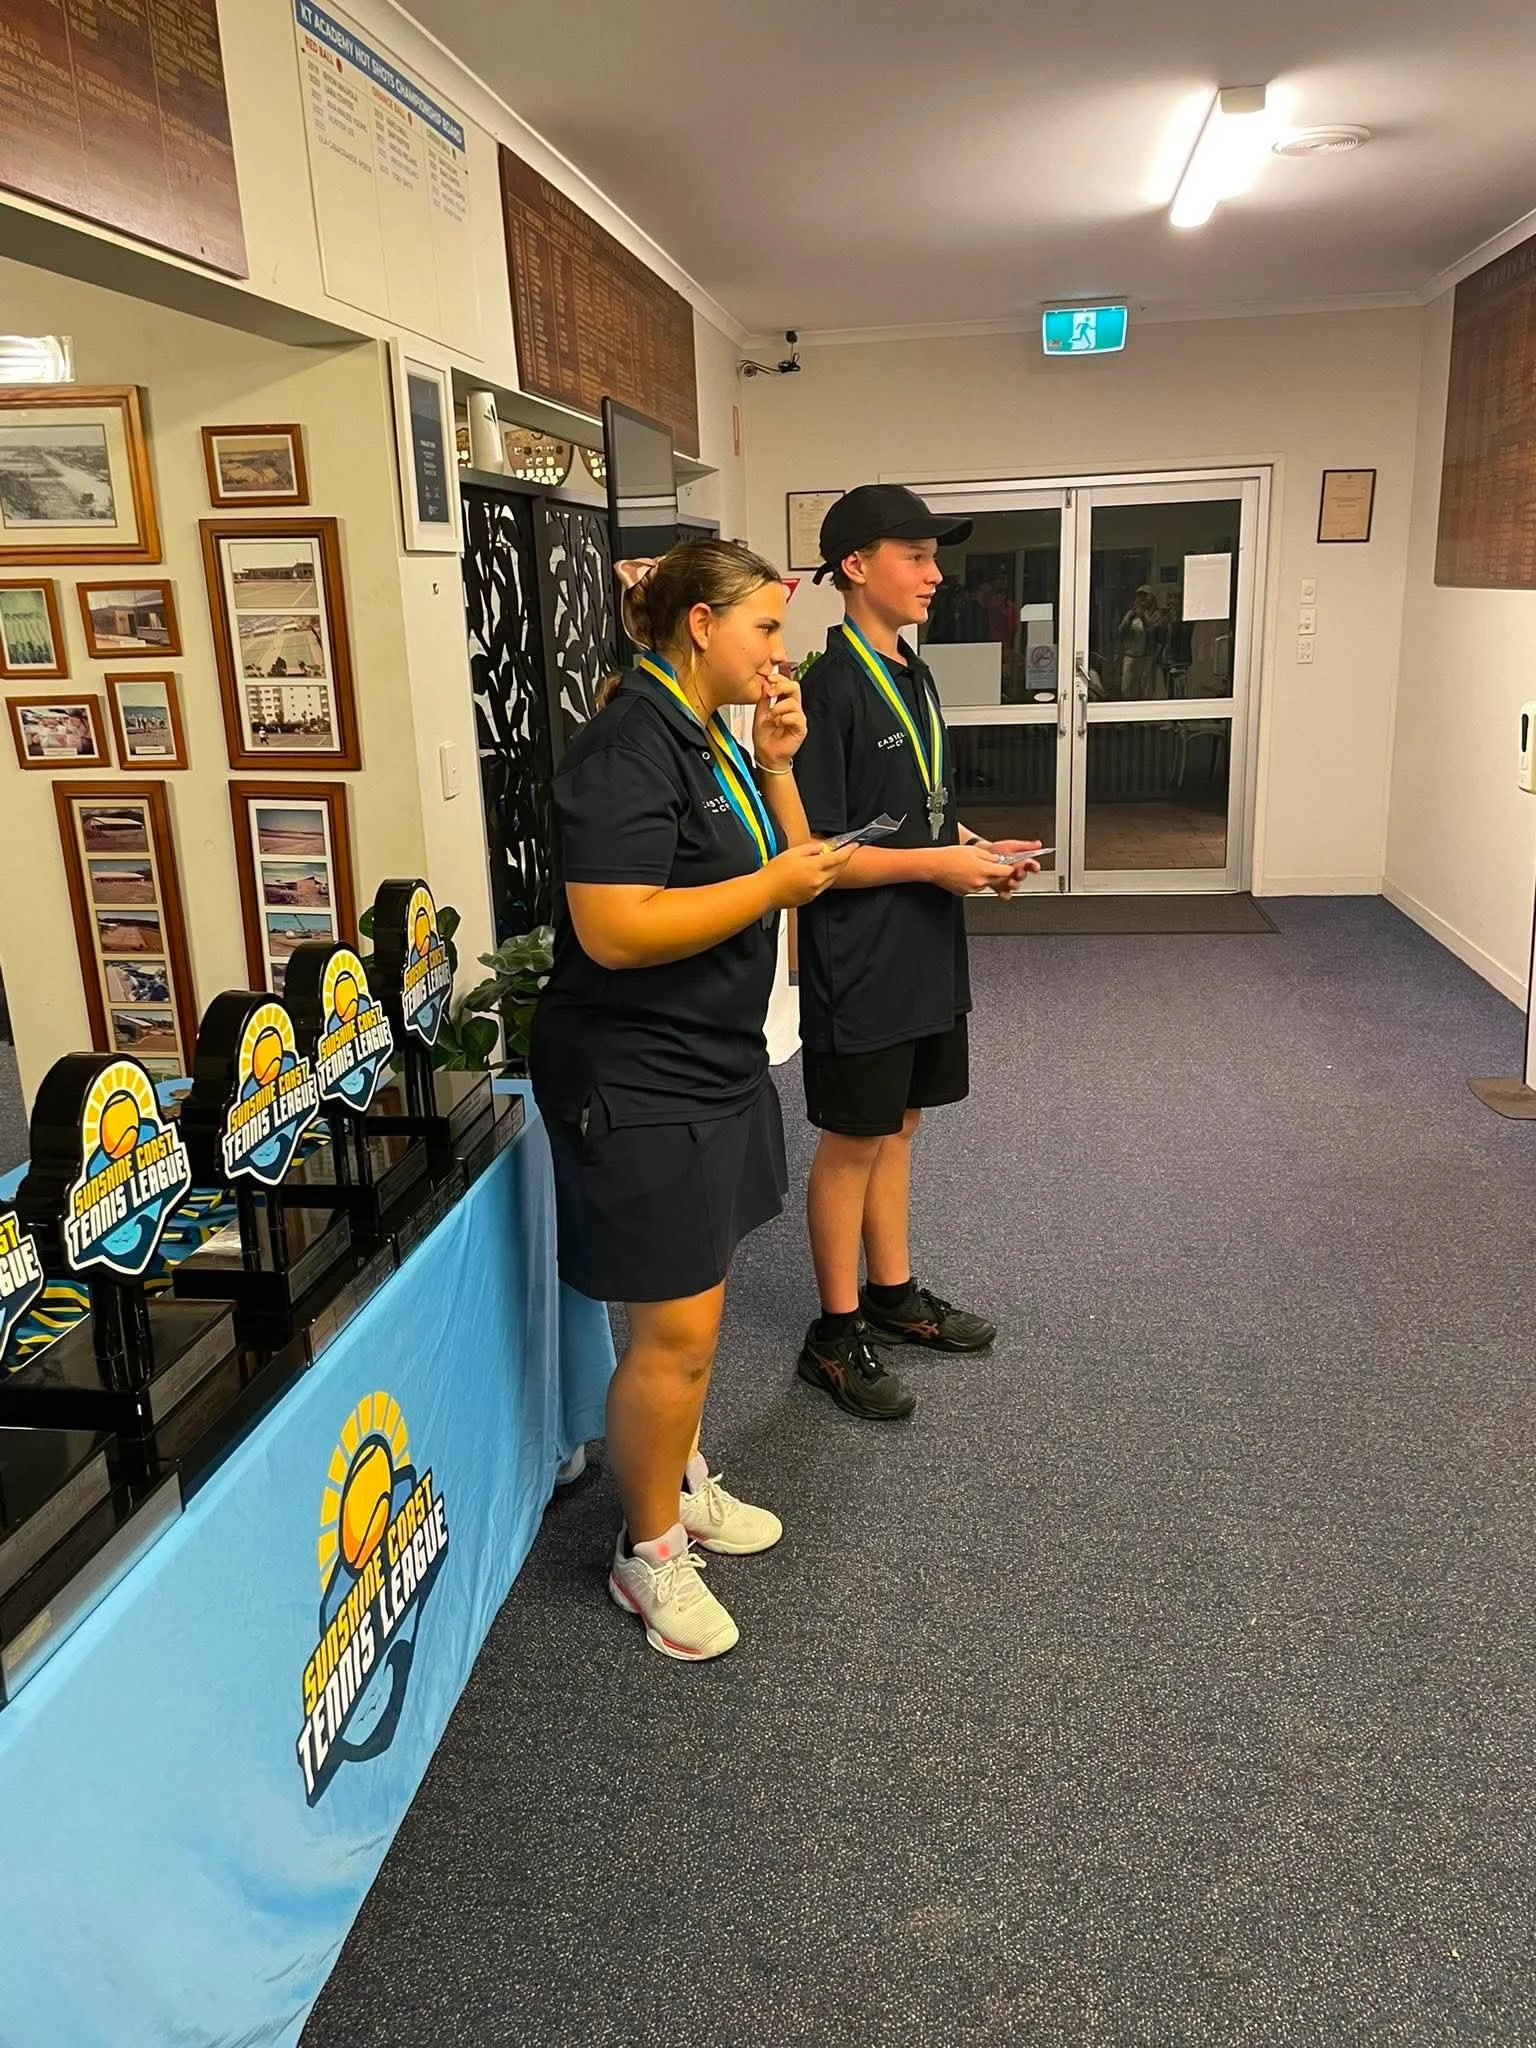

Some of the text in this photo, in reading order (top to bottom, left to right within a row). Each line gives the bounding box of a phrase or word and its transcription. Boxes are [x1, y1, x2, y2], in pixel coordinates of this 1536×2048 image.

[300, 2, 312, 25] KT
[314, 13, 354, 56] ACADEMY
[354, 44, 371, 70] HOT
[371, 58, 395, 89] SHOTS
[320, 1006, 381, 1063] SUNSHINE COAST
[404, 962, 450, 1021] TENNIS LEAGUE
[231, 1062, 308, 1134] SUNSHINE COAST
[318, 1022, 391, 1092] TENNIS LEAGUE
[226, 1079, 316, 1168] TENNIS LEAGUE
[69, 1150, 187, 1258] TENNIS LEAGUE
[75, 1131, 174, 1218] SUNSHINE COAST
[0, 1241, 40, 1298] GUE
[303, 1473, 434, 1717] SUNSHINE COAST
[298, 1499, 448, 1796] TENNIS LEAGUE
